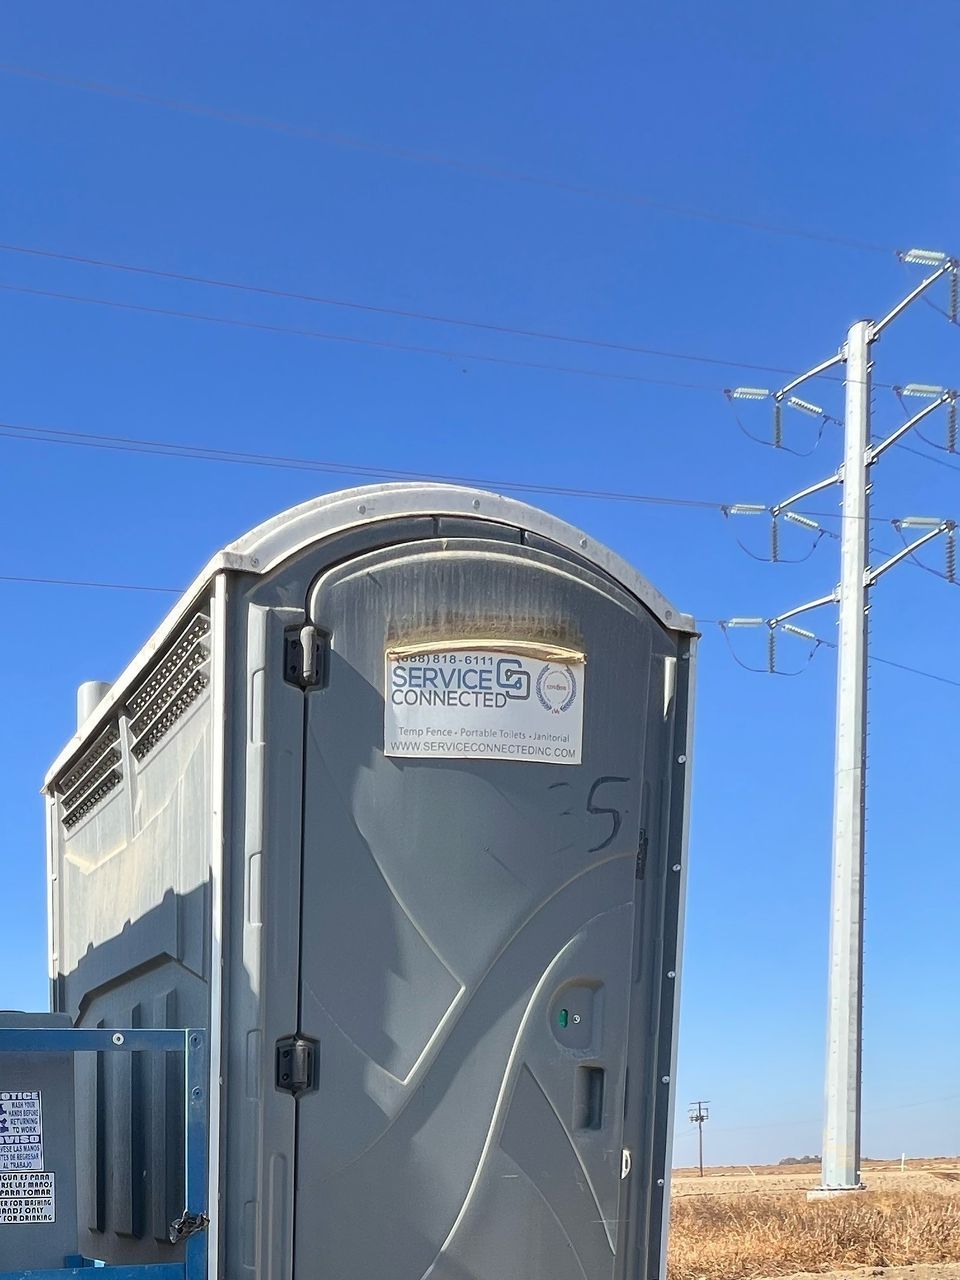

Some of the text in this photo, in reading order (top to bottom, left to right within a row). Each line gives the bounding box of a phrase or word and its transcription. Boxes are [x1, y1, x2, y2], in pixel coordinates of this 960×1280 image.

[392, 665, 493, 691] SERVICE
[391, 689, 508, 709] CONNECTED
[398, 727, 570, 743] Temp Fence Portable Toilets Janitorial
[390, 741, 576, 758] WWW.SERVICECONNECTEDINC.COM
[11, 1101, 36, 1109] WASH YOUR
[23, 1109, 39, 1117] BEFORE
[10, 1118, 38, 1126] RETURNING
[13, 1126, 37, 1134] TO WORK
[14, 1145, 22, 1153] LAS
[23, 1144, 40, 1152] MANOS
[10, 1161, 33, 1169] TRABAJO
[20, 1214, 52, 1222] DRINKING
